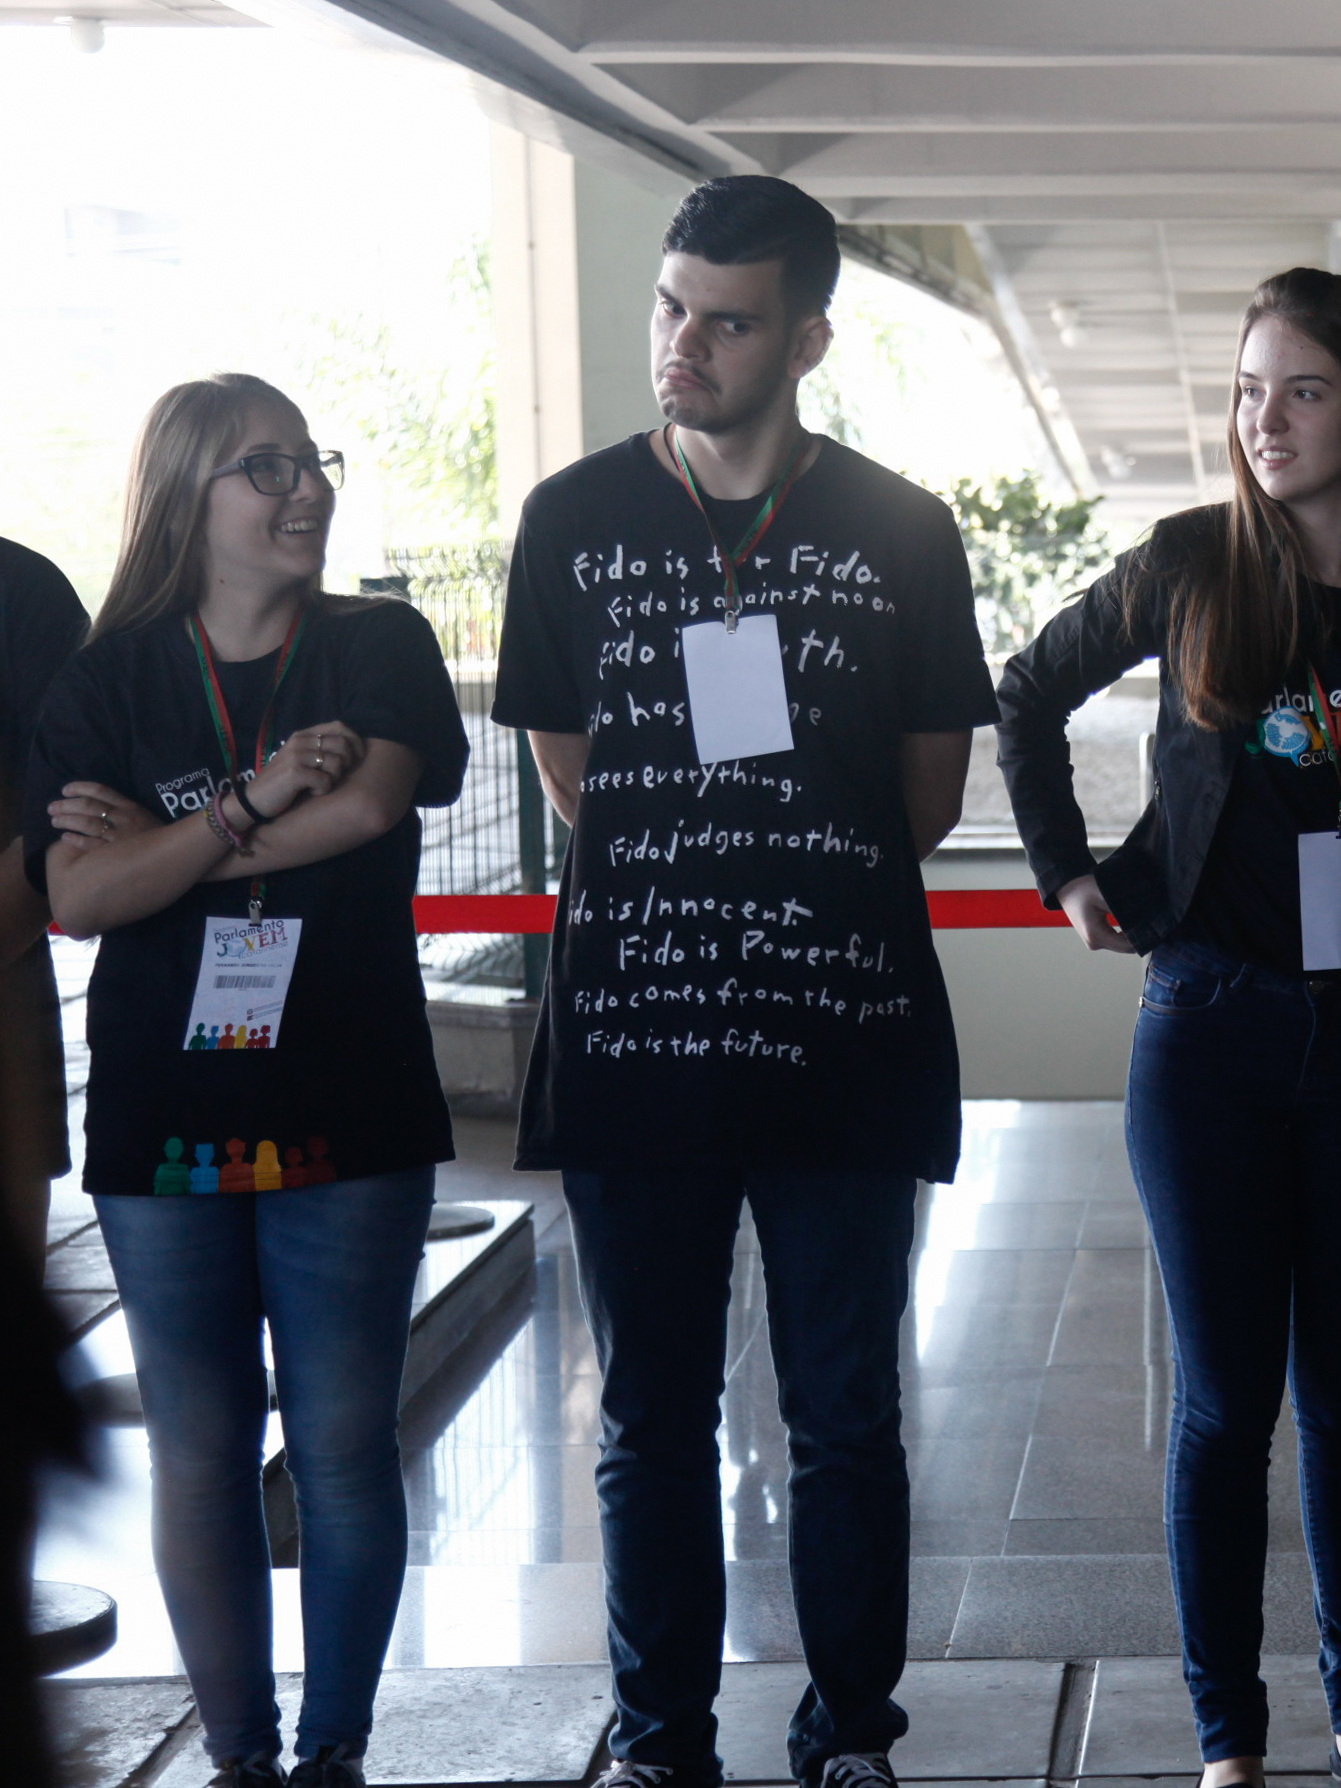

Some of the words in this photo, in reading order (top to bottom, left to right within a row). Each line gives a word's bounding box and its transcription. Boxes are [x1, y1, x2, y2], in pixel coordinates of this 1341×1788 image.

[573, 544, 647, 591] Fido
[666, 549, 689, 579] is
[789, 545, 880, 584] Fido.
[608, 591, 667, 628] Fido
[680, 587, 699, 616] is
[714, 582, 821, 608] aainst
[599, 630, 655, 680] Fido
[674, 628, 681, 658] i
[627, 692, 685, 726] has
[155, 767, 210, 793] Programa
[160, 741, 286, 818] Parlam
[643, 759, 801, 802] everything.
[609, 829, 658, 867] Fido
[664, 819, 754, 865] judges
[768, 822, 884, 868] nothing.
[569, 889, 593, 925] ido
[609, 896, 633, 920] is
[214, 919, 284, 943] Parlamento
[620, 930, 685, 971] Fido
[700, 934, 718, 960] is
[742, 931, 893, 973] Powerful.
[575, 988, 618, 1014] Fido
[629, 984, 706, 1008] comes
[717, 977, 793, 1006] from
[805, 987, 846, 1015] the
[587, 1030, 637, 1058] Fido
[646, 1028, 663, 1054] is
[670, 1031, 710, 1056] the
[721, 1028, 806, 1066] future.
